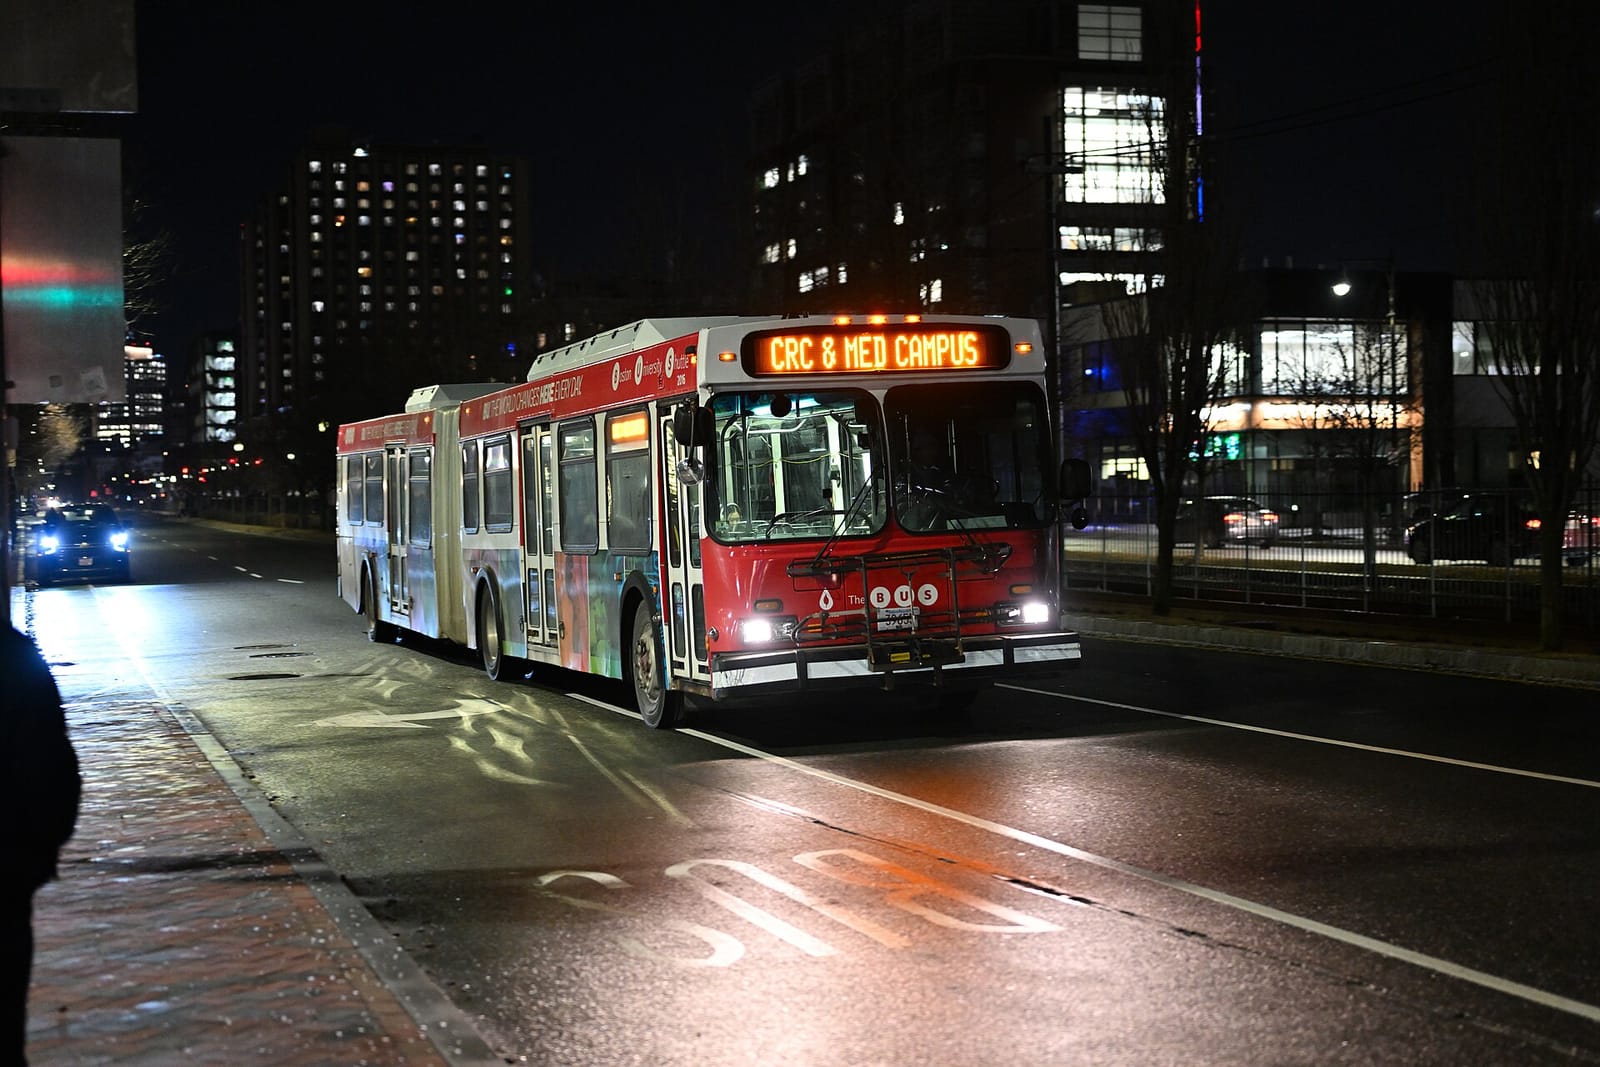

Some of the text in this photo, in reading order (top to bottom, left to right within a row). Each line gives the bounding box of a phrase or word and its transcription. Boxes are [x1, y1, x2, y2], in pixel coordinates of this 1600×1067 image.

[770, 332, 979, 370] CRC & MED CAMPUS
[635, 356, 663, 380] University
[667, 350, 689, 373] Shuttle
[540, 382, 555, 405] HERE
[848, 587, 935, 605] The BUS
